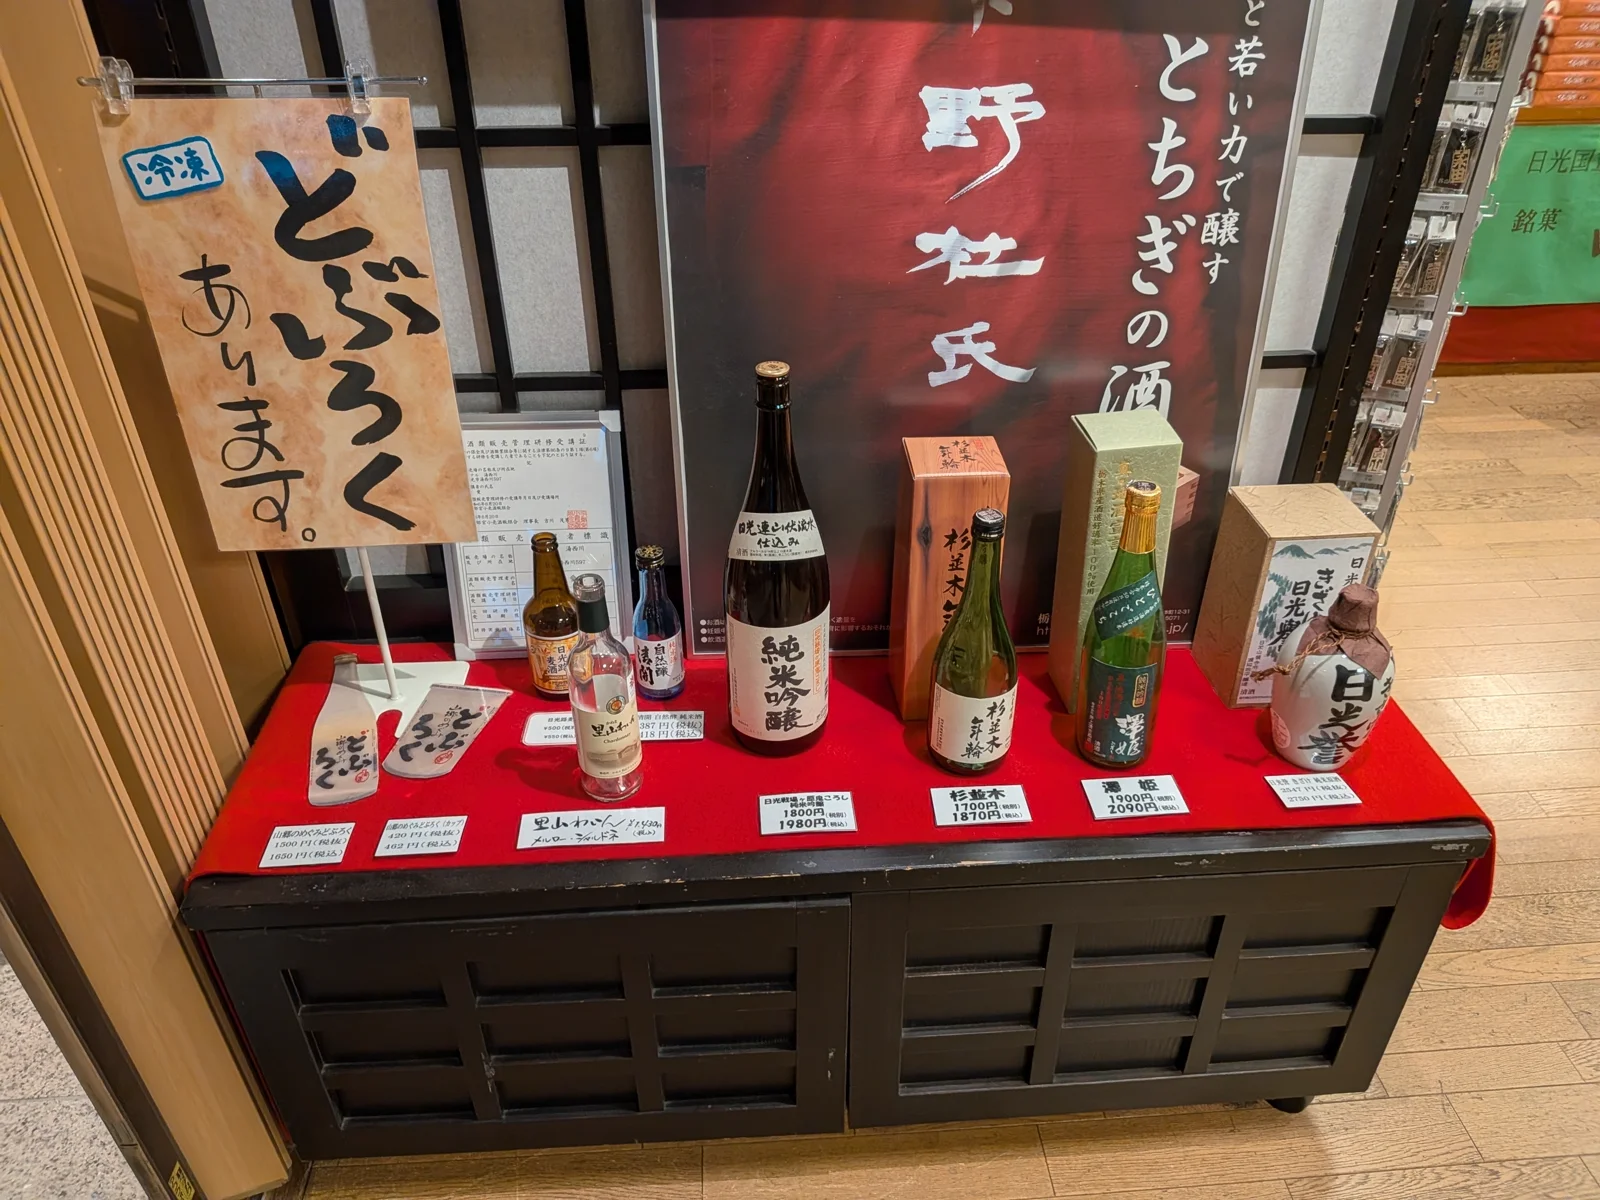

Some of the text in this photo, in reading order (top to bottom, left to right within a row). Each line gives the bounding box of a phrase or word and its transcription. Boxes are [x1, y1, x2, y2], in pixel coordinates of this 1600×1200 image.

[136, 148, 210, 188] 冷凍
[1511, 207, 1562, 234] 銘菓
[255, 114, 441, 532] どぶろく
[178, 254, 317, 542] あります。
[756, 536, 800, 549] 仕込み
[1098, 588, 1157, 625] ひとごこち
[760, 634, 814, 732] 純米吟醸
[983, 698, 1006, 754] 杉並木
[949, 788, 1006, 803] 杉並木
[269, 852, 293, 861] 1650
[275, 841, 298, 849] 1500
